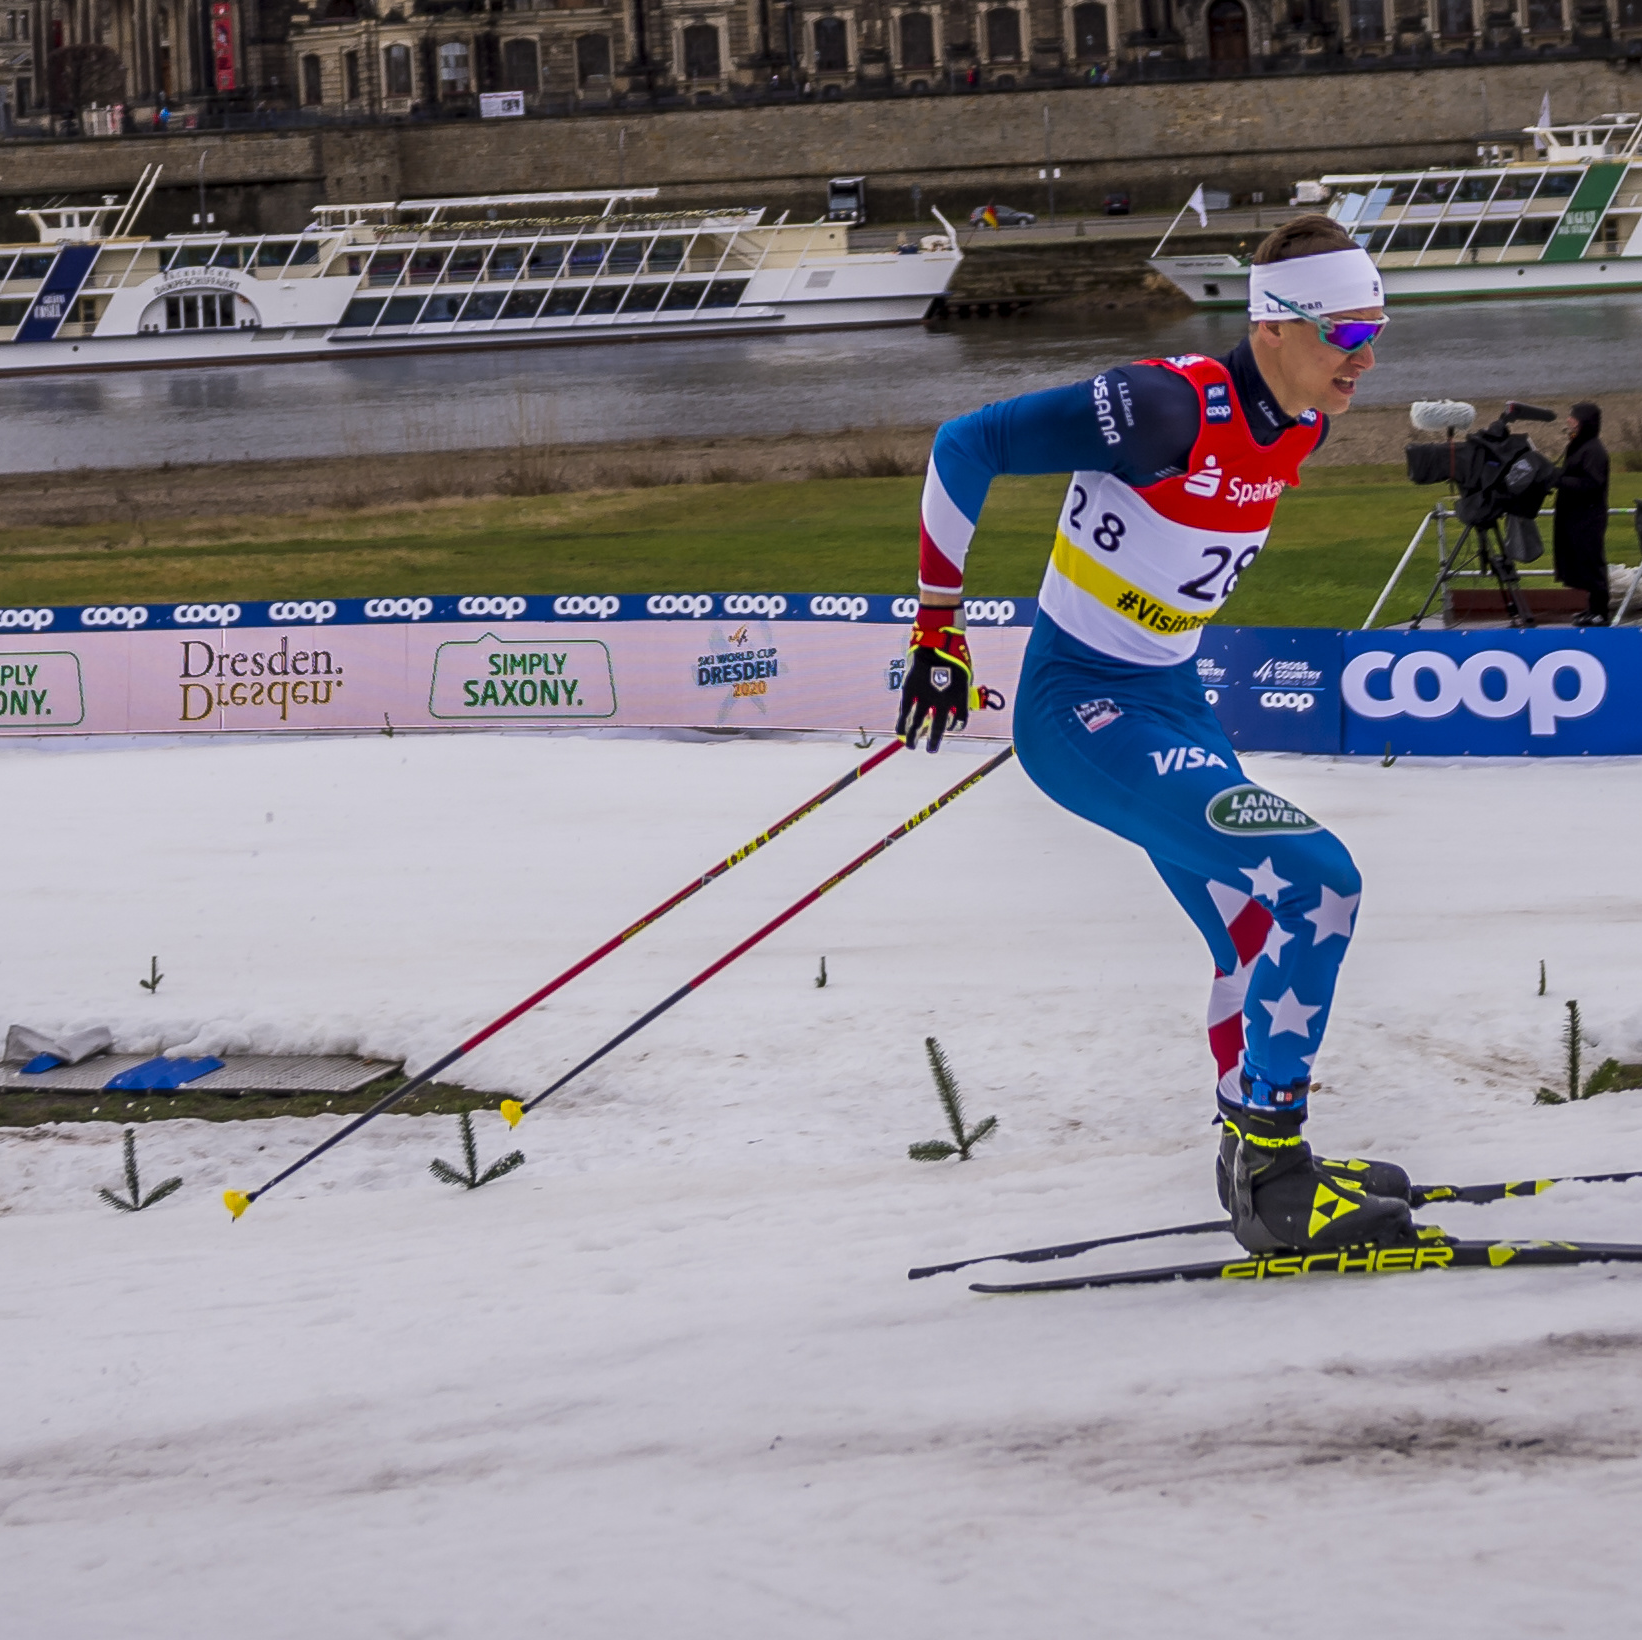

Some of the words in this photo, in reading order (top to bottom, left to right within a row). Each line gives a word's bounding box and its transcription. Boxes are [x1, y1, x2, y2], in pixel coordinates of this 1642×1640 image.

[1178, 545, 1260, 602] 28
[81, 607, 148, 629] coop
[173, 604, 241, 627] coop
[269, 602, 336, 624] coop
[364, 600, 433, 621] coop
[458, 598, 526, 620] coop
[554, 595, 619, 618] coop
[647, 594, 713, 618] coop
[724, 594, 787, 618] coop
[810, 596, 868, 620] coop
[891, 597, 920, 618] co
[179, 635, 344, 678] Dresden.
[488, 653, 567, 676] SIMPLY
[716, 650, 755, 664] WORLD
[756, 647, 777, 659] CUP
[698, 659, 777, 686] DRESDEN
[463, 679, 584, 706] SAXONY.
[733, 680, 768, 697] 2020
[1260, 691, 1315, 713] coop
[1341, 649, 1607, 735] coop
[1146, 746, 1229, 776] VISA
[1231, 793, 1286, 810] LAND
[1237, 808, 1307, 825] ROVER
[1220, 1245, 1455, 1281] FISCHER
